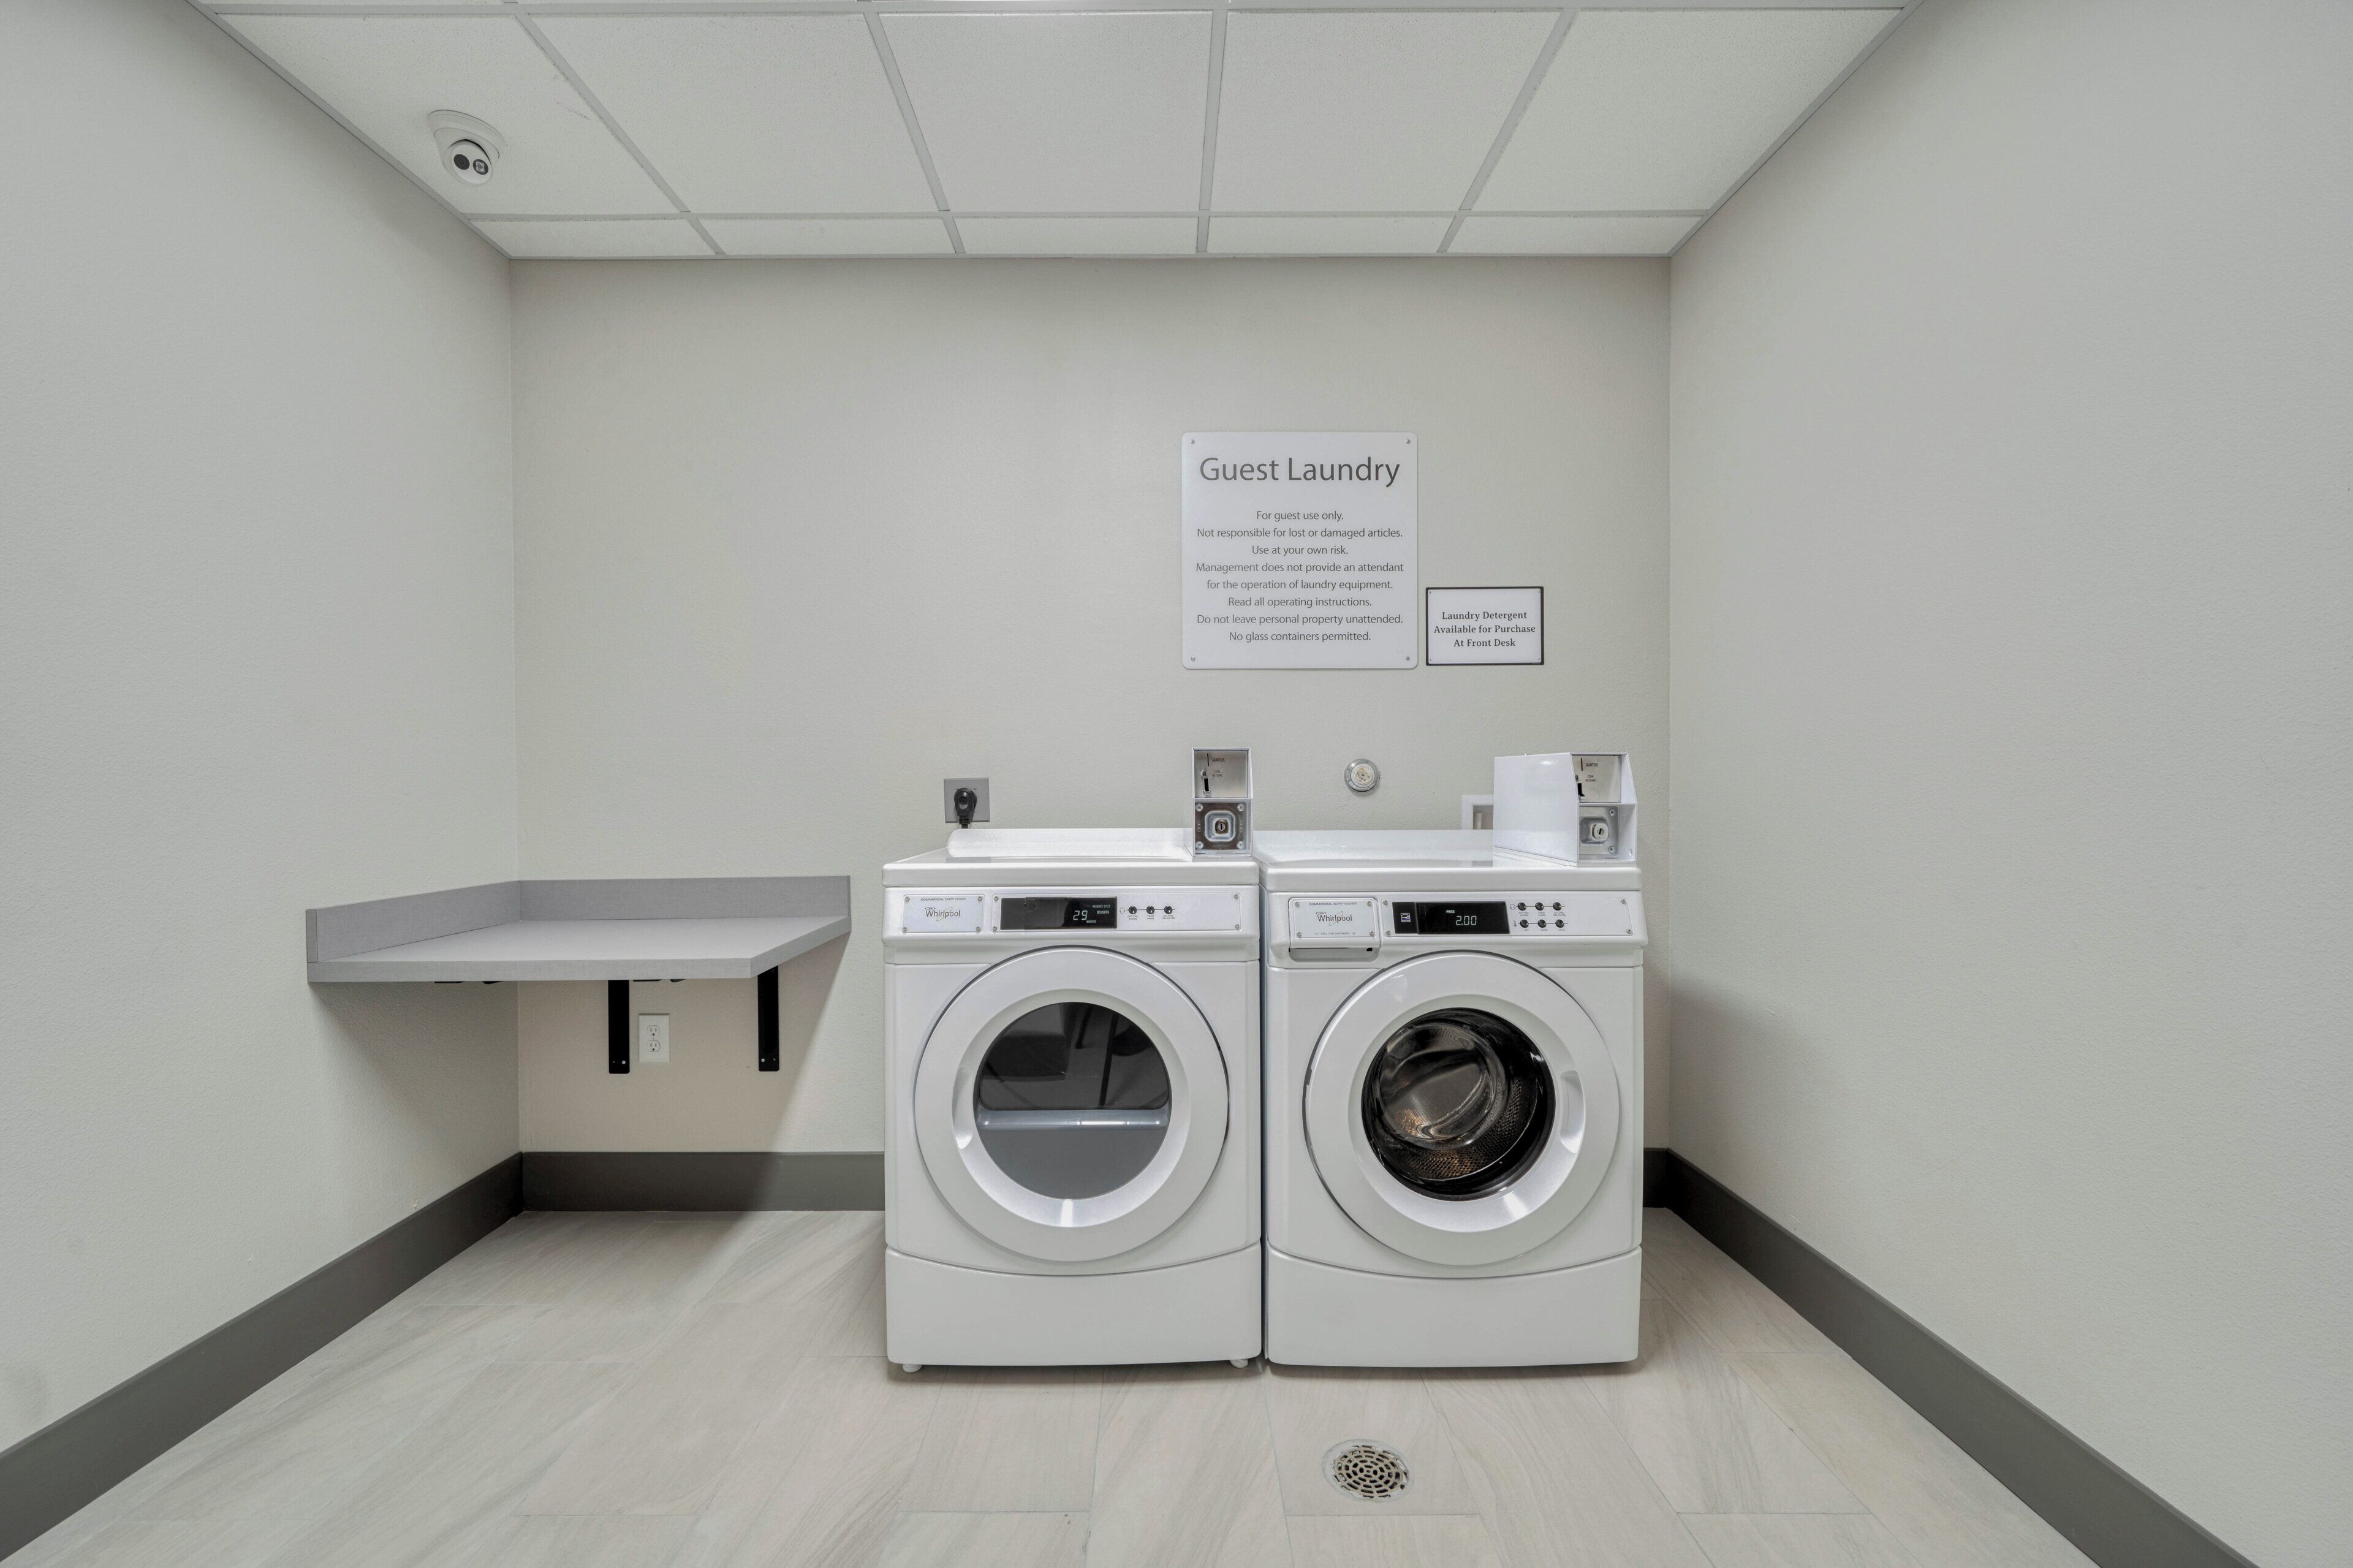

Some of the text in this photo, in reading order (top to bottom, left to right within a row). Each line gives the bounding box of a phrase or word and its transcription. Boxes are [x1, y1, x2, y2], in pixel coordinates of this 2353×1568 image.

[1200, 456, 1401, 488] Guest Laundry
[1256, 510, 1272, 520] For
[1274, 512, 1301, 522] guest
[1321, 510, 1344, 523] only.
[1197, 528, 1214, 537] Not
[1217, 527, 1271, 539] responsible
[1273, 527, 1287, 537] for
[1289, 528, 1306, 537] lost
[1320, 528, 1365, 540] damaged
[1368, 528, 1403, 537] articles.
[1252, 545, 1270, 555] Use
[1271, 546, 1281, 555] at
[1283, 547, 1305, 557] your
[1330, 545, 1348, 555] risk.
[1196, 562, 1259, 574] Management
[1261, 562, 1284, 572] does
[1305, 562, 1341, 574] provide
[1357, 562, 1404, 572] attendant
[1206, 579, 1393, 591] for the operation of laundry equipment.
[1228, 597, 1372, 608] Read all operating instructions.
[1197, 613, 1403, 626] Do not leave personal property unattended.
[1442, 611, 1527, 621] Laundry Detergent
[1433, 624, 1536, 634] Available for Purchase
[1229, 631, 1371, 643] No glass containers permitted.
[1466, 638, 1491, 647] Front
[1494, 638, 1516, 646] Desk
[925, 910, 961, 919] Whirlpool
[1073, 910, 1088, 920] 29
[1317, 914, 1352, 923] Whirlpool
[1455, 915, 1477, 926] 2.00
